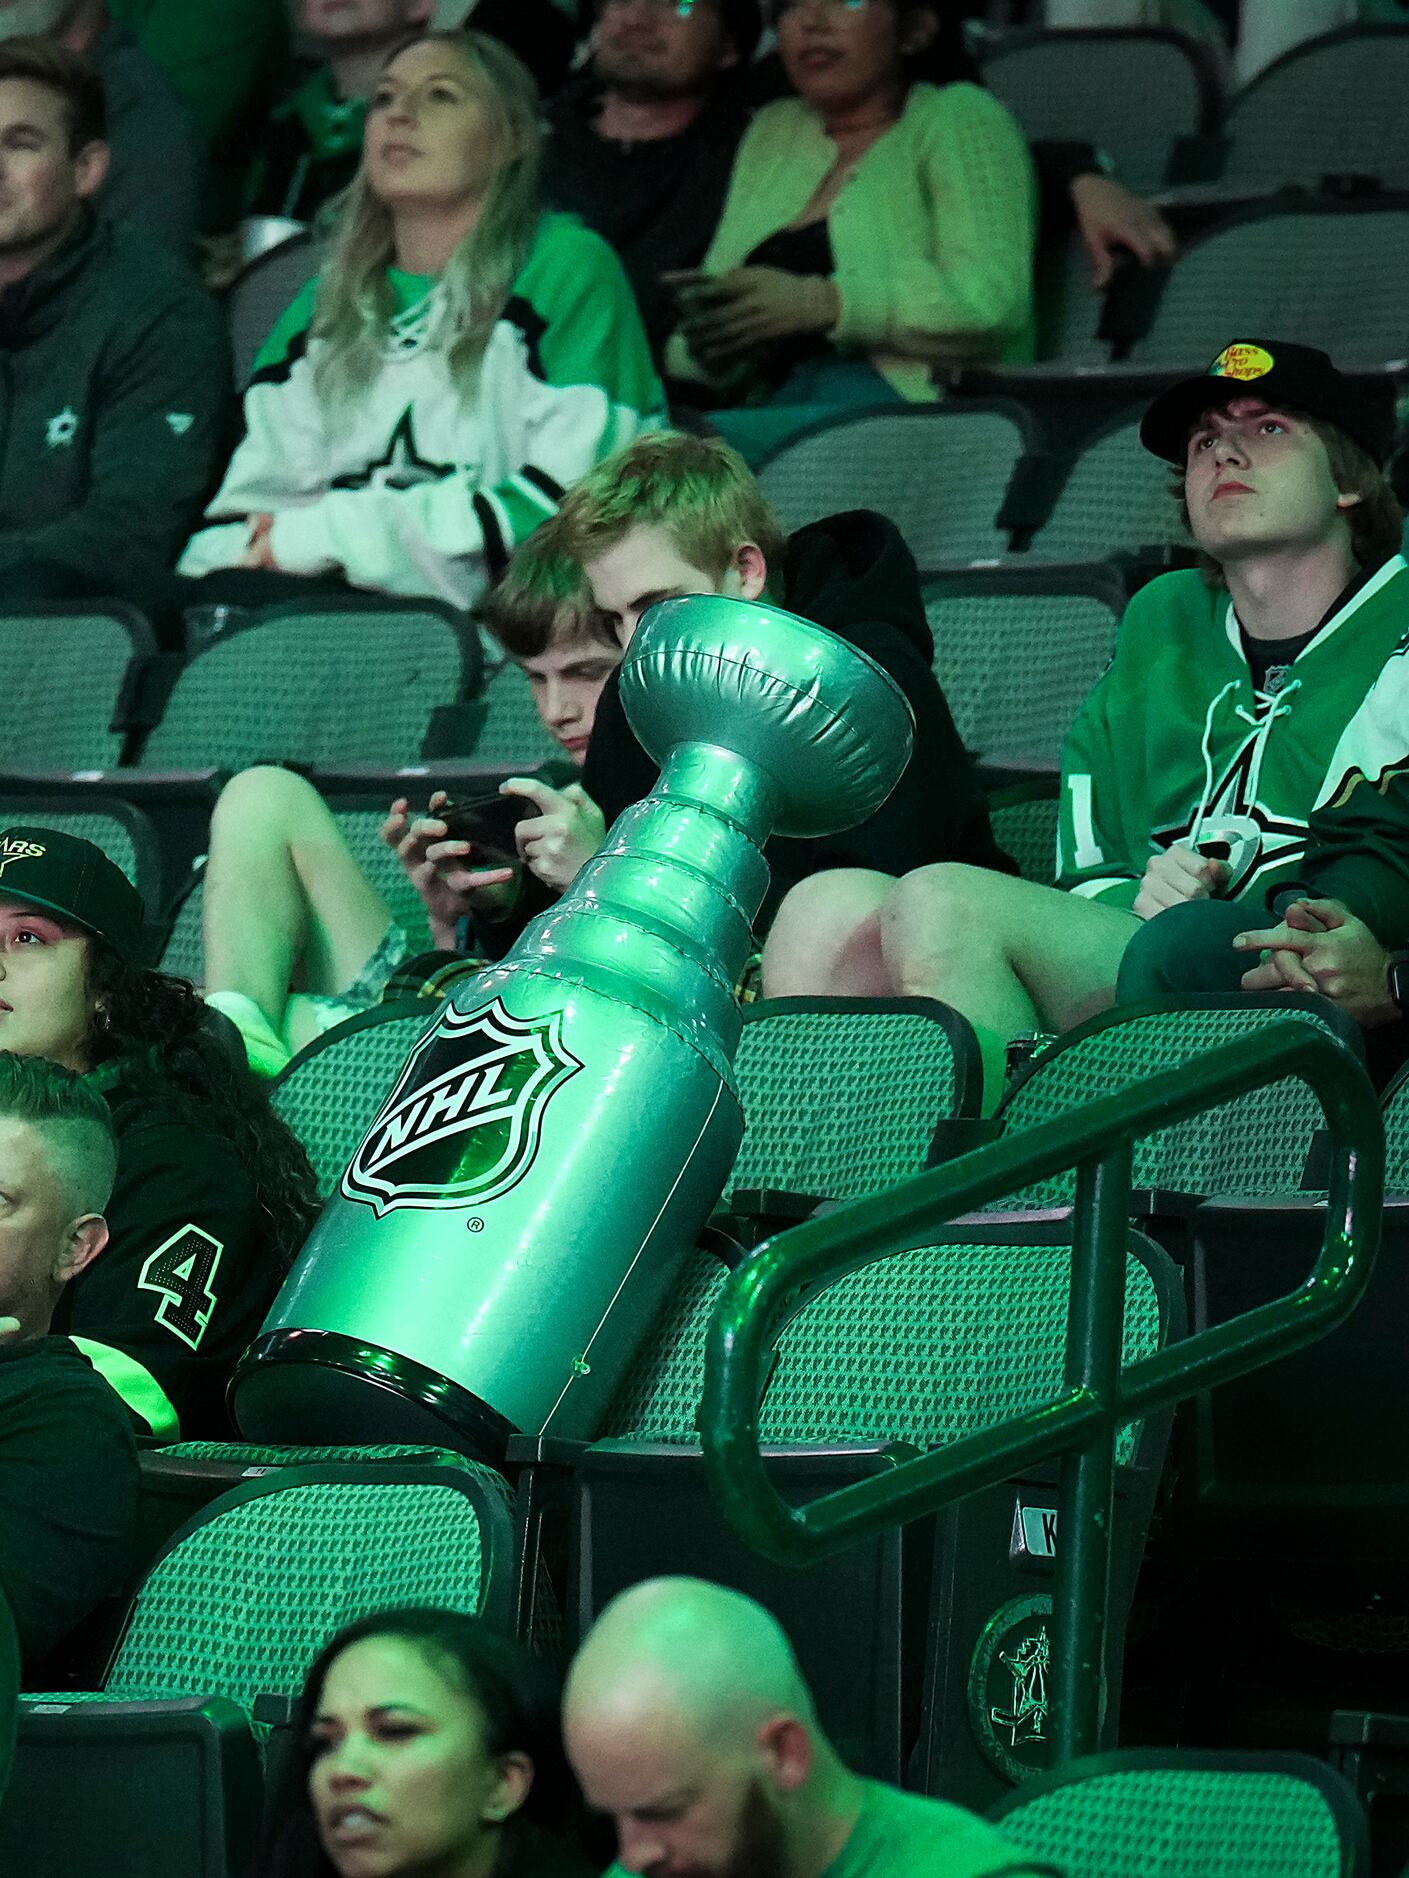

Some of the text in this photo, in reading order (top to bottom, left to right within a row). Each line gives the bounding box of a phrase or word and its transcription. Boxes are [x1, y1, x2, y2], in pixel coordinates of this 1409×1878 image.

[1068, 773, 1104, 869] 1
[367, 1063, 513, 1166] NHL
[137, 1222, 224, 1351] 4
